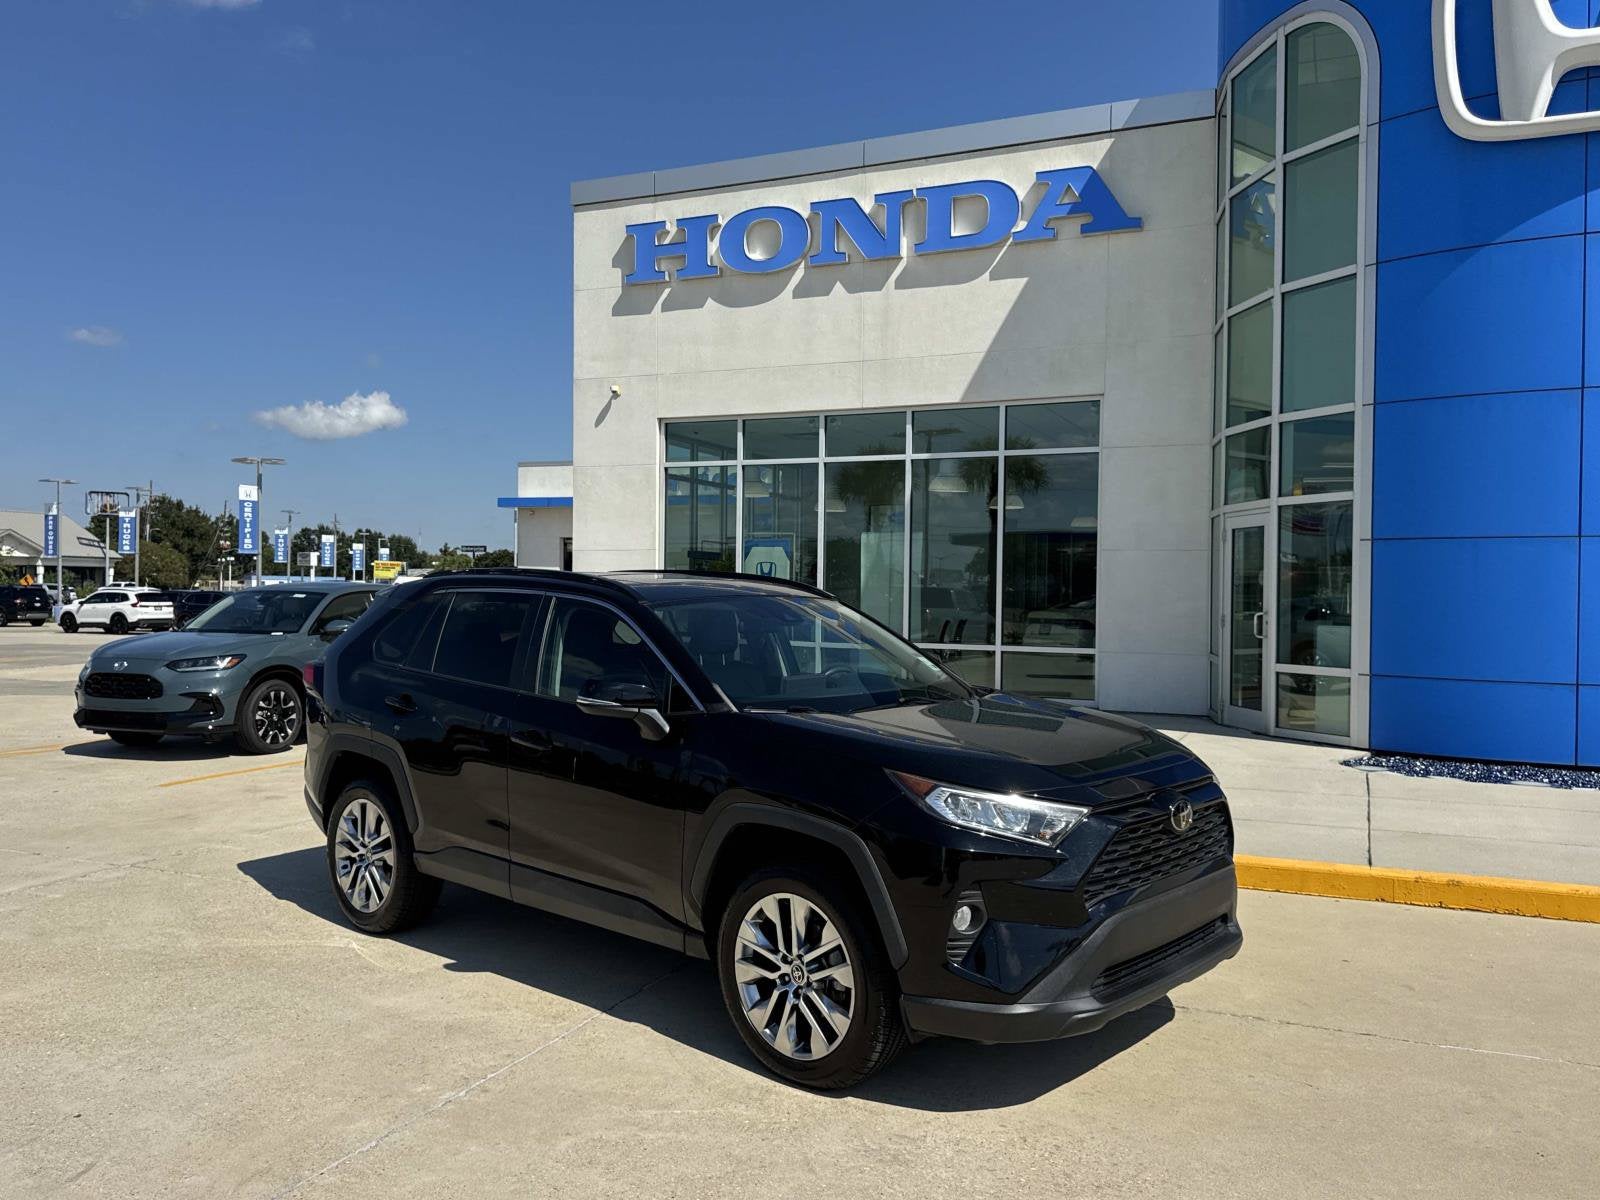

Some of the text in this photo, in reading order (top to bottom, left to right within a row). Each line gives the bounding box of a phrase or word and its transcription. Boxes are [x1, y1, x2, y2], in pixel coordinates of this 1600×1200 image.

[625, 165, 1143, 285] HONDA
[122, 517, 131, 550] TRUCKS
[243, 501, 253, 549] CERTIFIED
